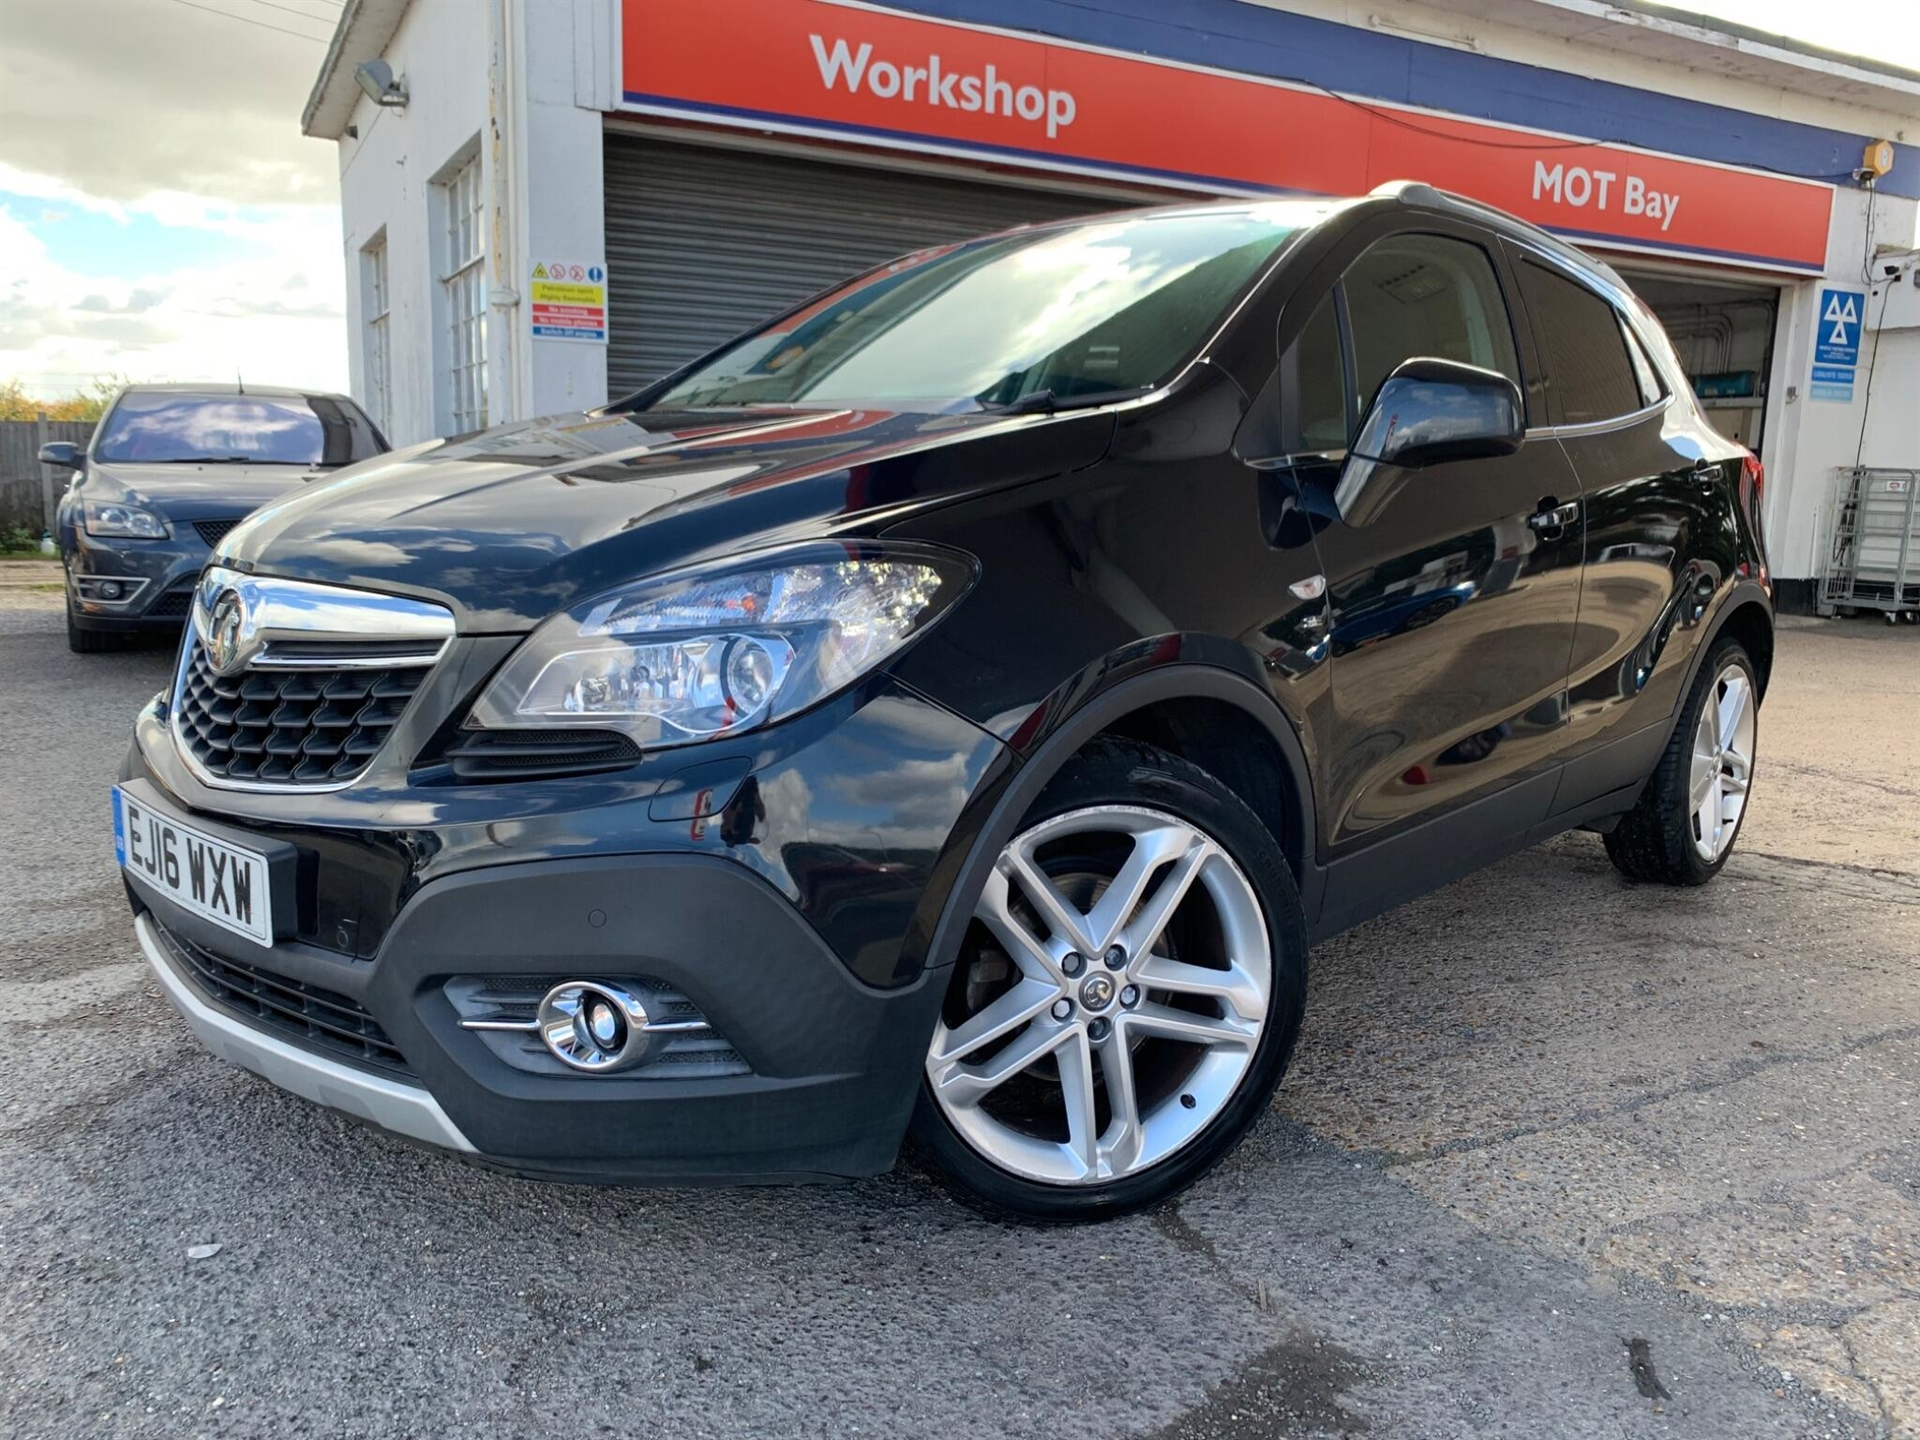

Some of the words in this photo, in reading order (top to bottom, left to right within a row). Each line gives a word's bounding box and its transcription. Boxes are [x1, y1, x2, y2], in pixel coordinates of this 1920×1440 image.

[809, 33, 1077, 139] Workshop
[1532, 160, 1616, 210] MOT
[1623, 176, 1680, 231] Bay
[128, 805, 180, 890] EJ16
[186, 837, 251, 926] WXW
